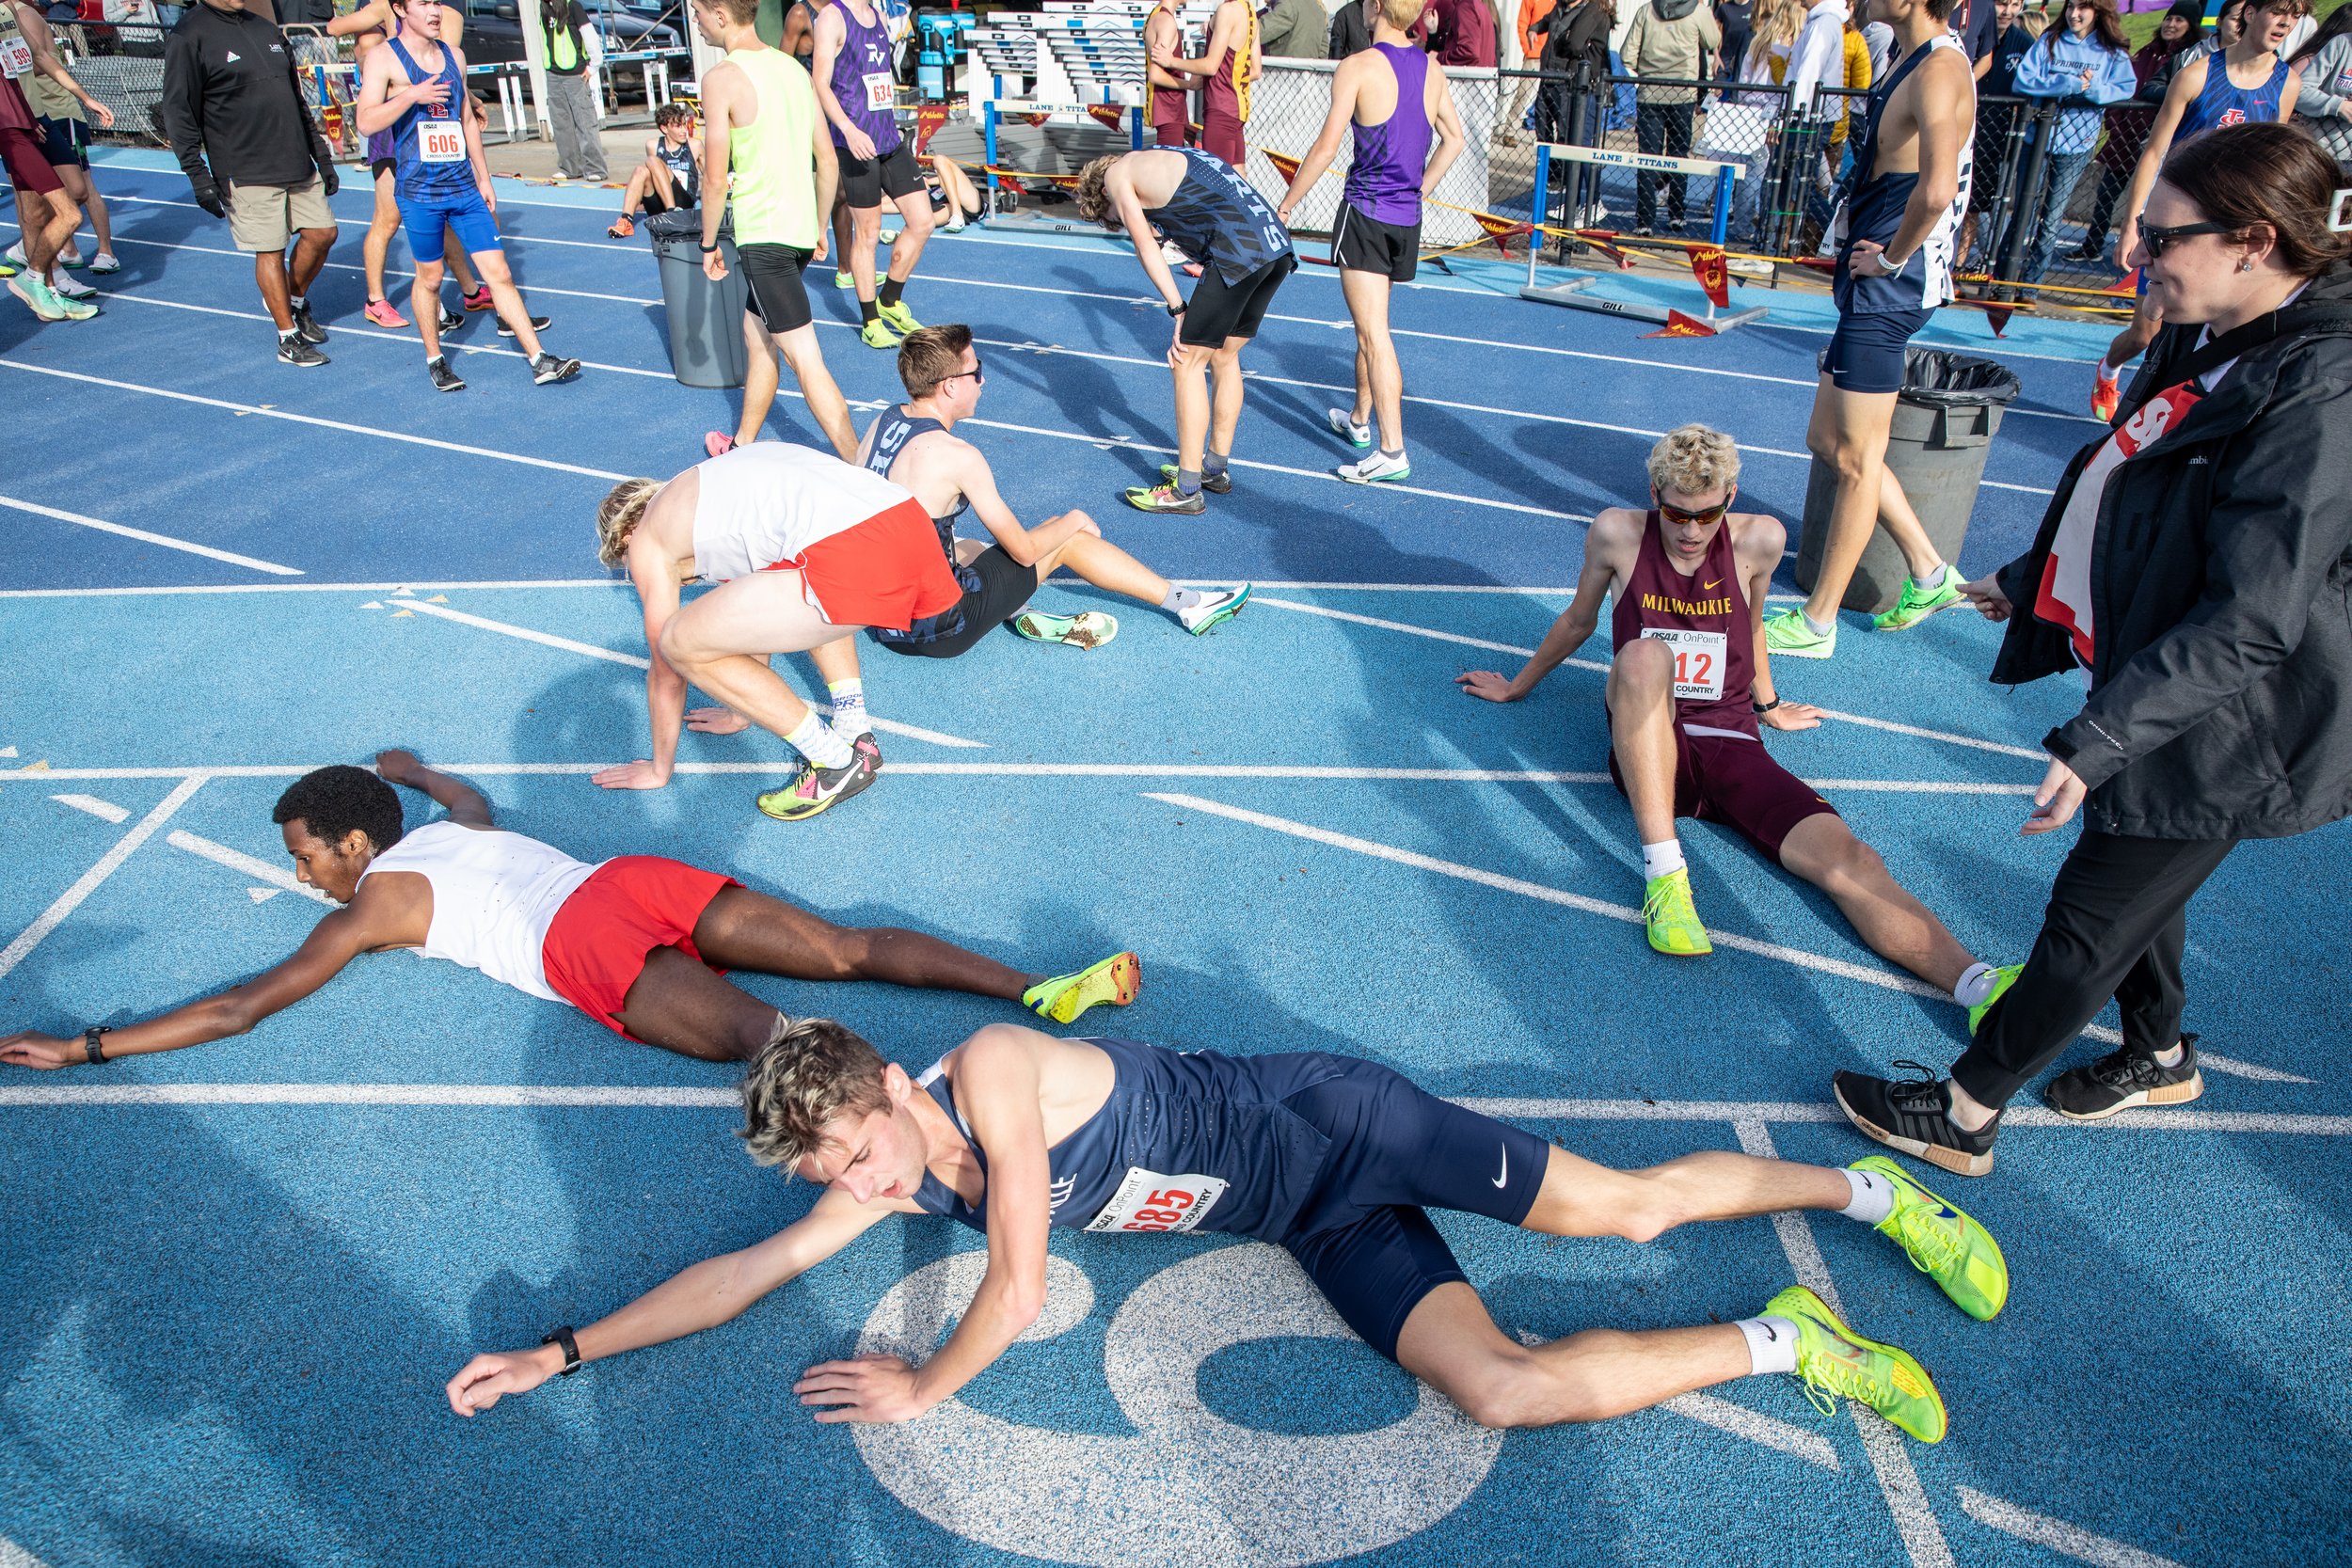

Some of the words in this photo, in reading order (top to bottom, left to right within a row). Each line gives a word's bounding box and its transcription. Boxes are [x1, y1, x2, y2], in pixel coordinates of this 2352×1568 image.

[12, 48, 31, 65] 599
[2052, 59, 2101, 71] SPRINGFIELD
[873, 84, 893, 103] 634
[920, 111, 945, 119] Athletic
[1029, 103, 1054, 112] LANE
[1089, 105, 1120, 119] Athletic
[428, 135, 459, 153] 606
[1592, 151, 1623, 163] LANE
[1637, 157, 1678, 169] TITANS
[1480, 220, 1507, 234] Athleti
[1601, 301, 1624, 311] GILL
[1642, 593, 1732, 616] MILWAUKIE
[1650, 631, 1679, 641] OSAA
[1683, 632, 1720, 644] OnPoint
[1676, 652, 1712, 685] 12
[1676, 685, 1715, 694] COUNTRY
[2089, 720, 2124, 751] OMNI-TECH
[1092, 1213, 1117, 1230] OSAA
[1109, 1179, 1142, 1212] OnPoint
[1122, 1188, 1195, 1230] 685
[1182, 1188, 1214, 1223] COUNTRY
